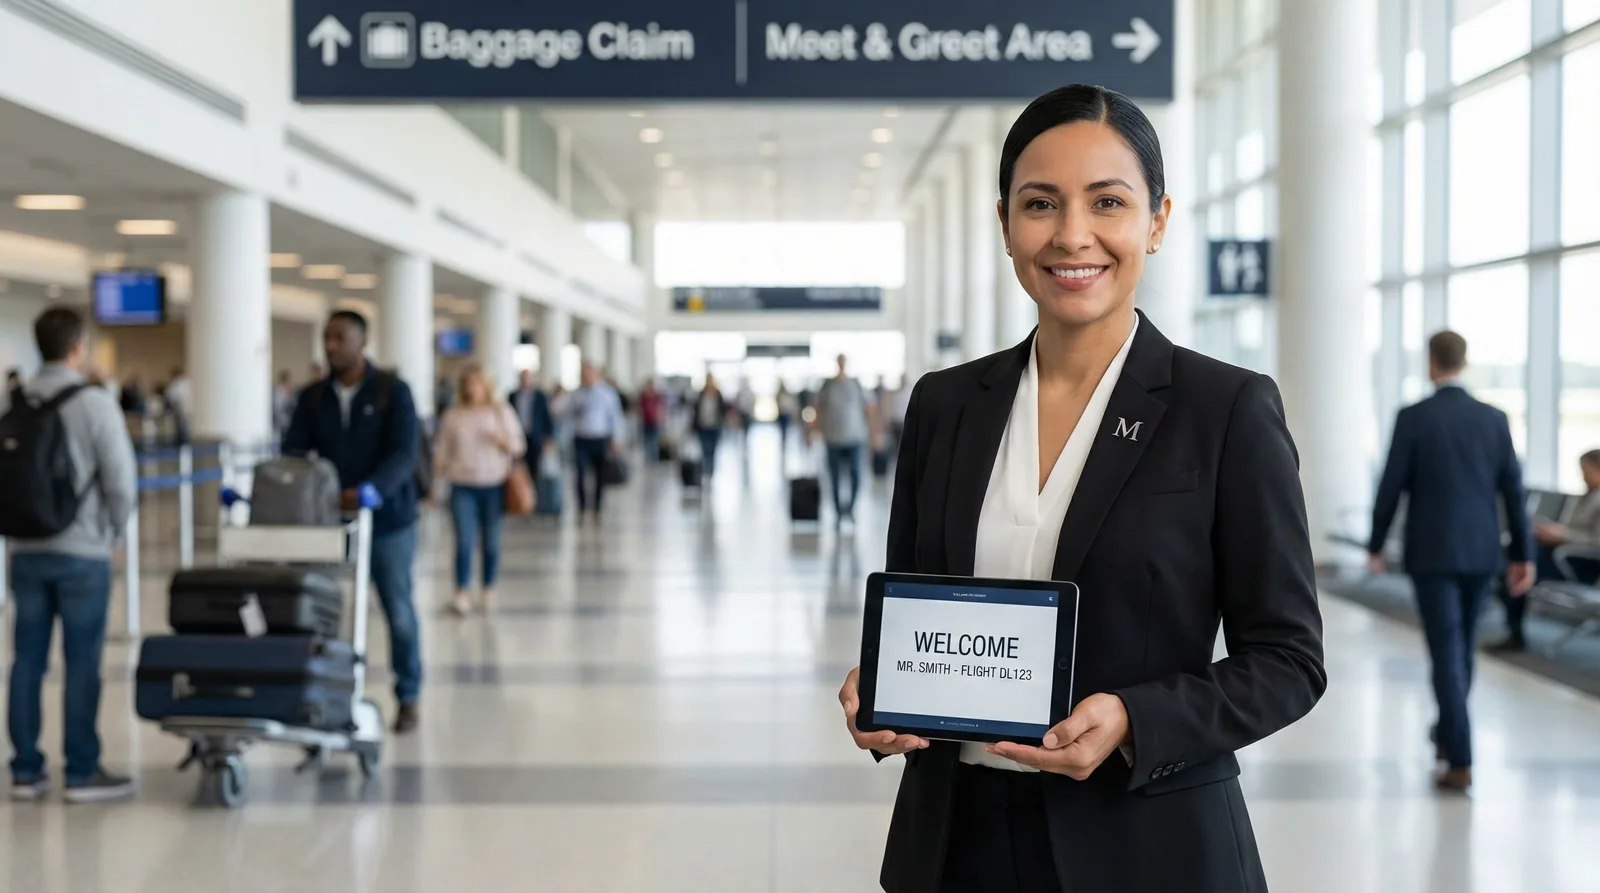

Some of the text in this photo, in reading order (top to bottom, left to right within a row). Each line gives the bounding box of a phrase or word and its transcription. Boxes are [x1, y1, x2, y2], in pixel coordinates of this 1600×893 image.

[420, 22, 695, 68] Baggage Claim
[765, 22, 1092, 61] Meet & Greet Area
[1112, 417, 1143, 441] M
[914, 631, 1019, 658] WELCOME
[896, 660, 916, 673] MR.
[919, 662, 951, 675] SMITH
[961, 665, 996, 678] FLIGHT
[1000, 668, 1032, 680] DL123
